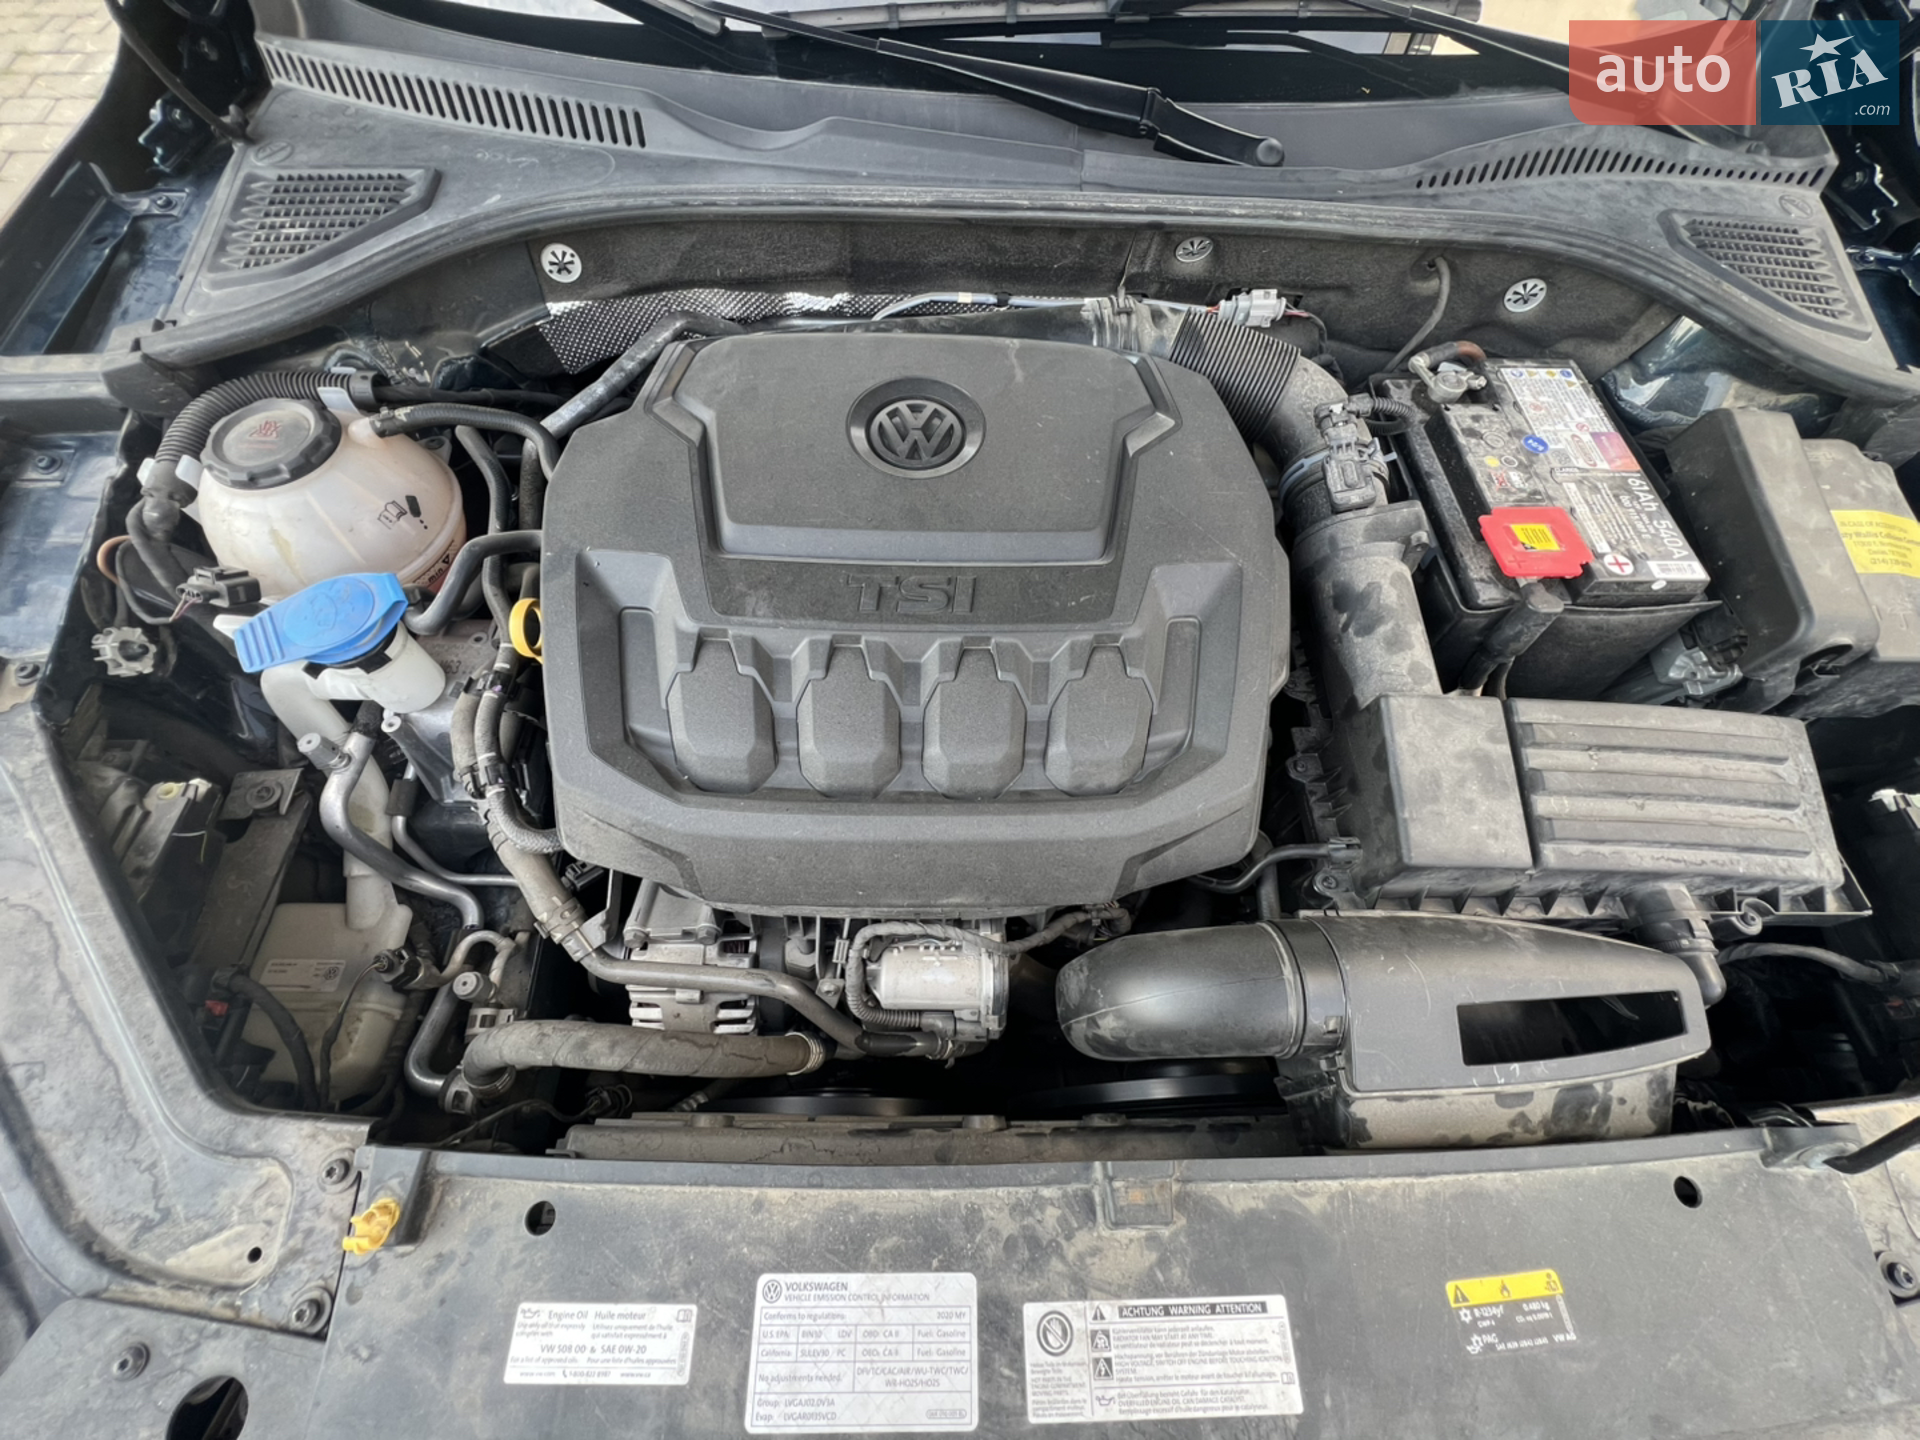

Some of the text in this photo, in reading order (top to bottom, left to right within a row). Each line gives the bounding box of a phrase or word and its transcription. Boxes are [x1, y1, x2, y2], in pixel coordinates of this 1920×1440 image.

[1628, 478, 1690, 559] 61Ah 540A
[847, 575, 977, 613] TSI
[784, 1282, 848, 1291] VOLKSWAGEN
[784, 1294, 810, 1302] VEHICLE
[813, 1294, 845, 1302] EMISSION
[882, 1292, 930, 1301] INFORMATION
[1122, 1303, 1262, 1317] ACHTUNG WARNING ATTENTION
[1473, 1304, 1504, 1318] R-1234yf
[1540, 1300, 1550, 1312] kg
[548, 1310, 588, 1322] Engine Oil
[594, 1311, 646, 1320] Huile moteur
[764, 1312, 796, 1320] Conforms
[798, 1312, 805, 1320] to
[936, 1312, 953, 1320] 2020
[936, 1329, 966, 1338] Gasoline
[1482, 1333, 1498, 1344] PAG
[1552, 1333, 1566, 1342] VW
[540, 1344, 556, 1354] VW
[557, 1344, 572, 1354] 508
[574, 1344, 586, 1354] 00
[601, 1344, 616, 1354] SAE
[618, 1344, 647, 1354] 0W-20
[936, 1348, 966, 1356] Gasoline
[759, 1374, 768, 1382] No
[770, 1374, 813, 1384] adjustments
